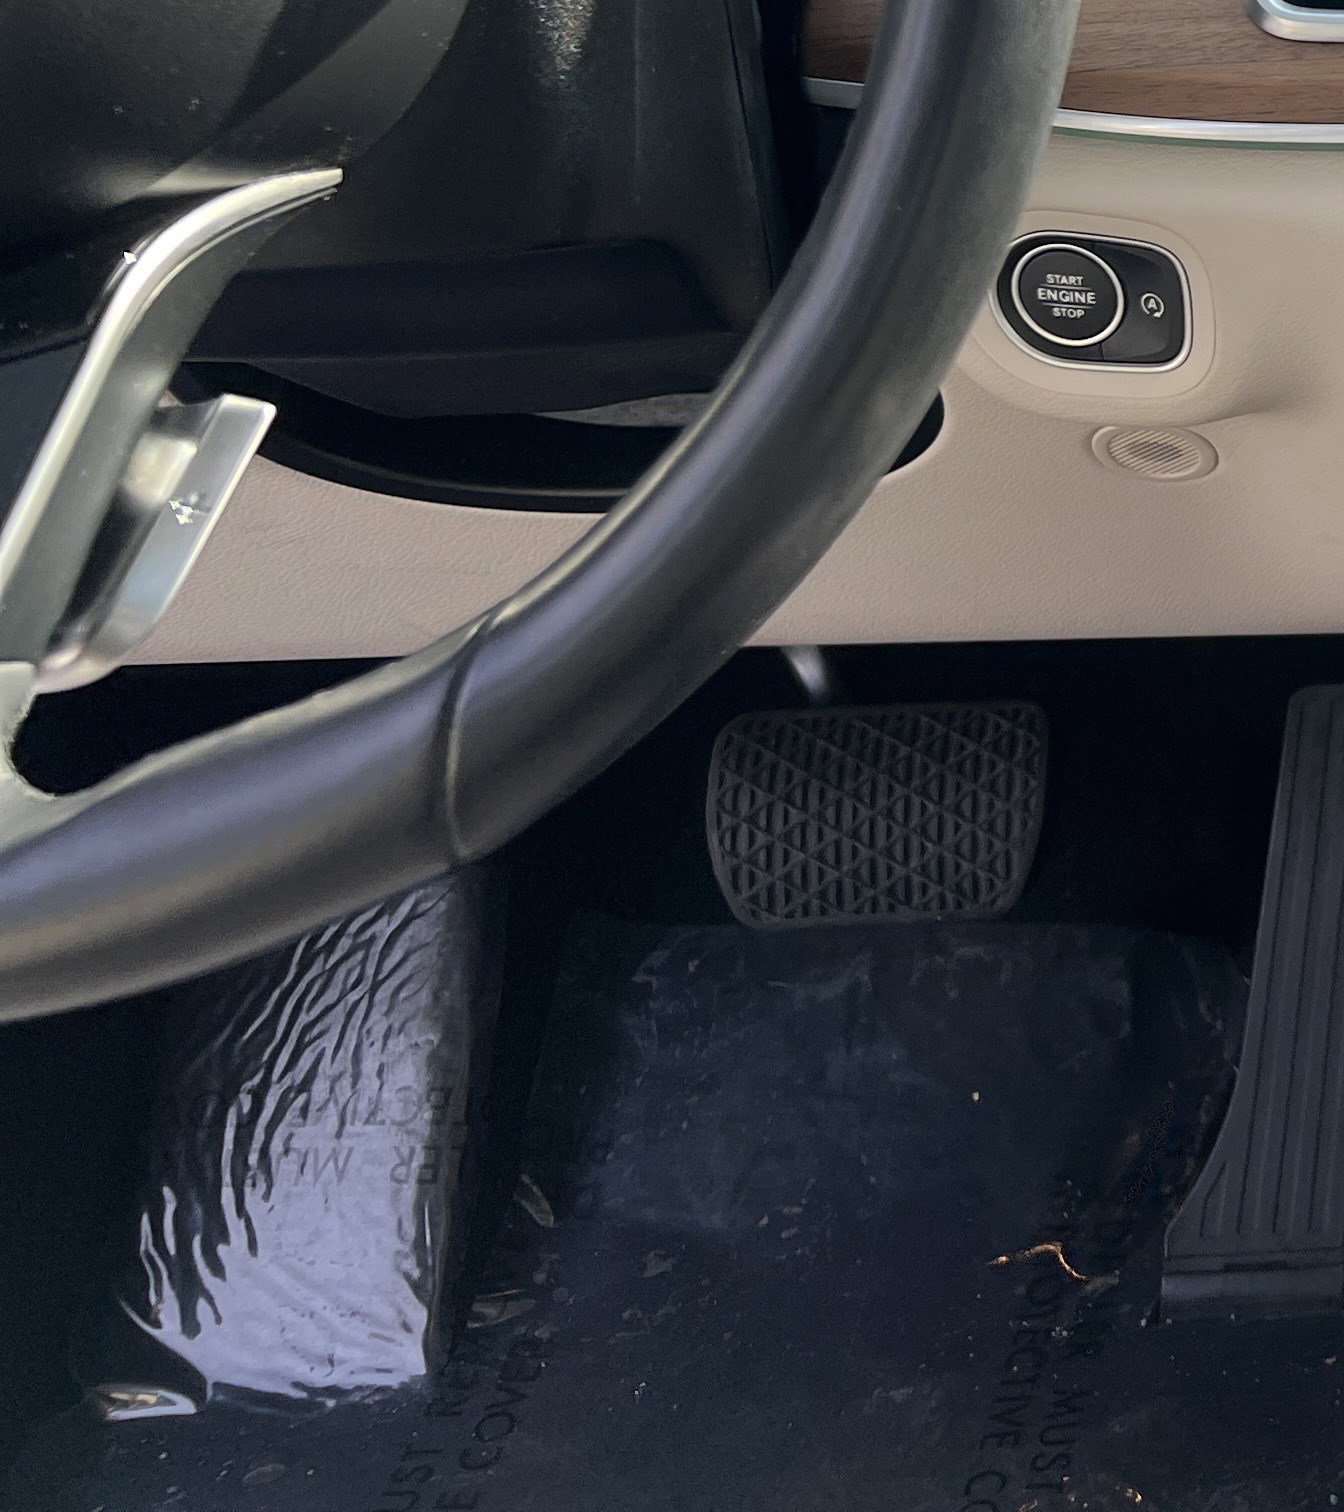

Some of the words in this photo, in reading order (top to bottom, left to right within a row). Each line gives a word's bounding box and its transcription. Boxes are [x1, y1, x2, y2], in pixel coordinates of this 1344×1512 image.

[1046, 273, 1084, 286] START
[1037, 287, 1097, 305] ENGINE
[1052, 307, 1085, 319] STOP
